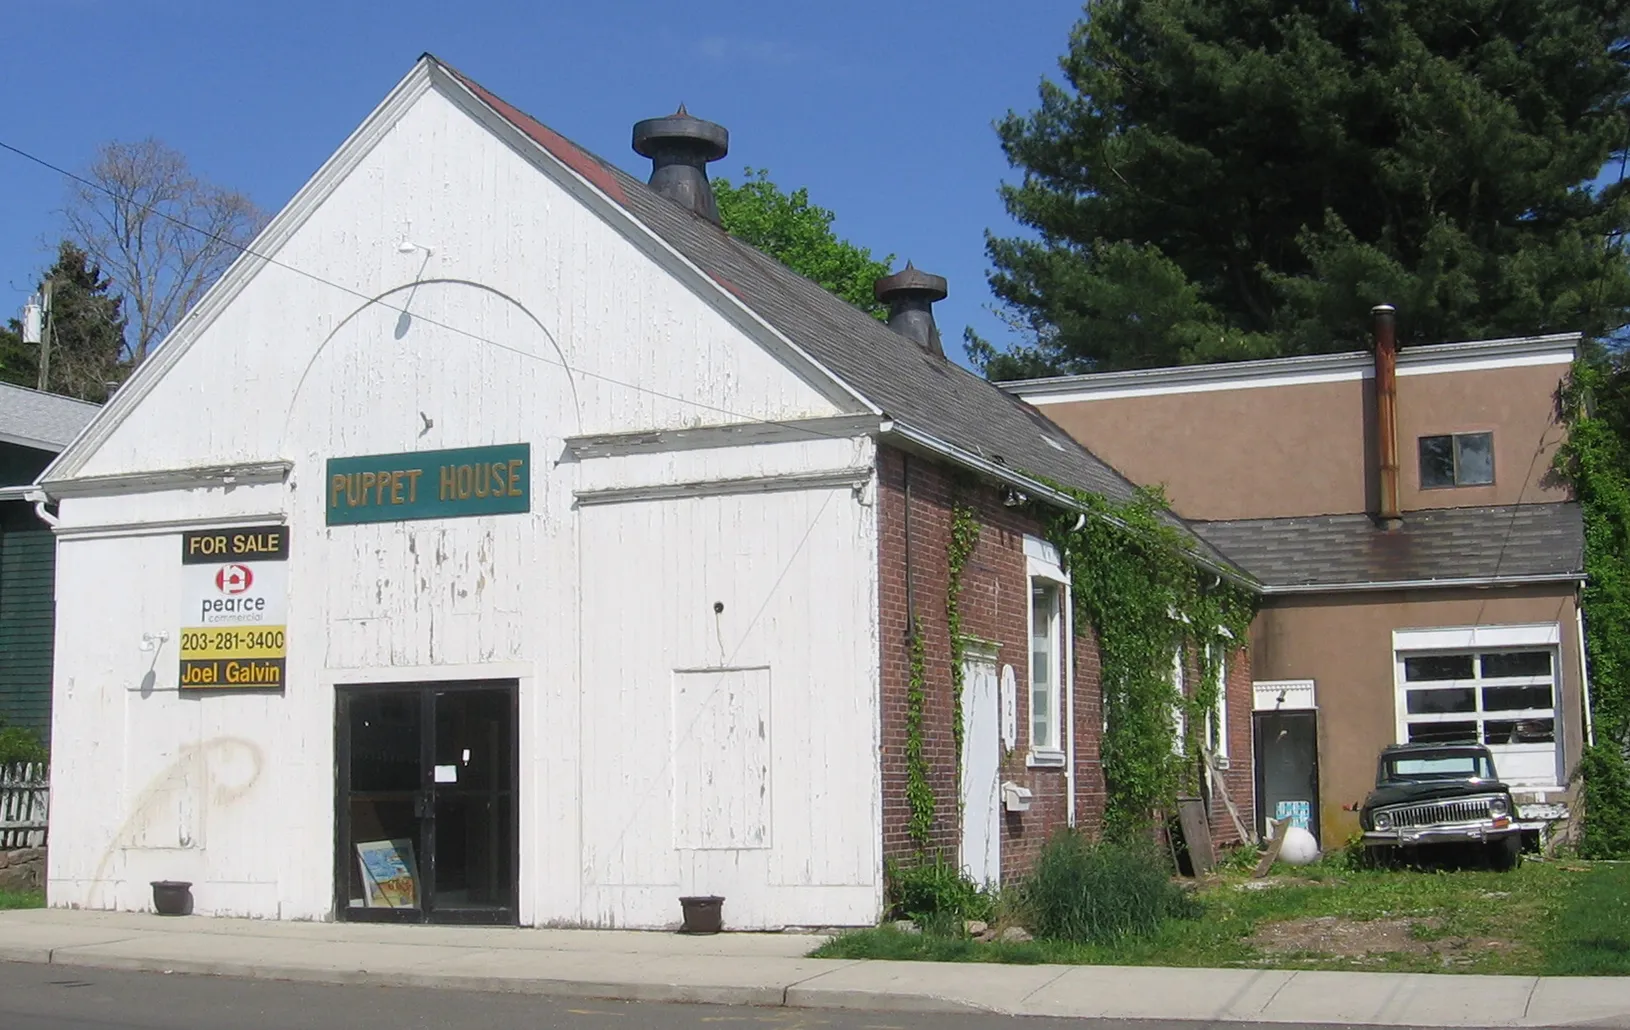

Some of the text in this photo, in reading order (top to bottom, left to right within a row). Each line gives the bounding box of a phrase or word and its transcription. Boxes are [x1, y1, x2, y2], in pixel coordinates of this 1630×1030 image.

[331, 459, 523, 508] PUPPET HOUSE
[190, 533, 279, 555] FOR SALE
[202, 597, 265, 622] pearce
[208, 612, 263, 623] commercial
[181, 631, 284, 651] 203-281-3400
[181, 661, 280, 683] Joel Galvin
